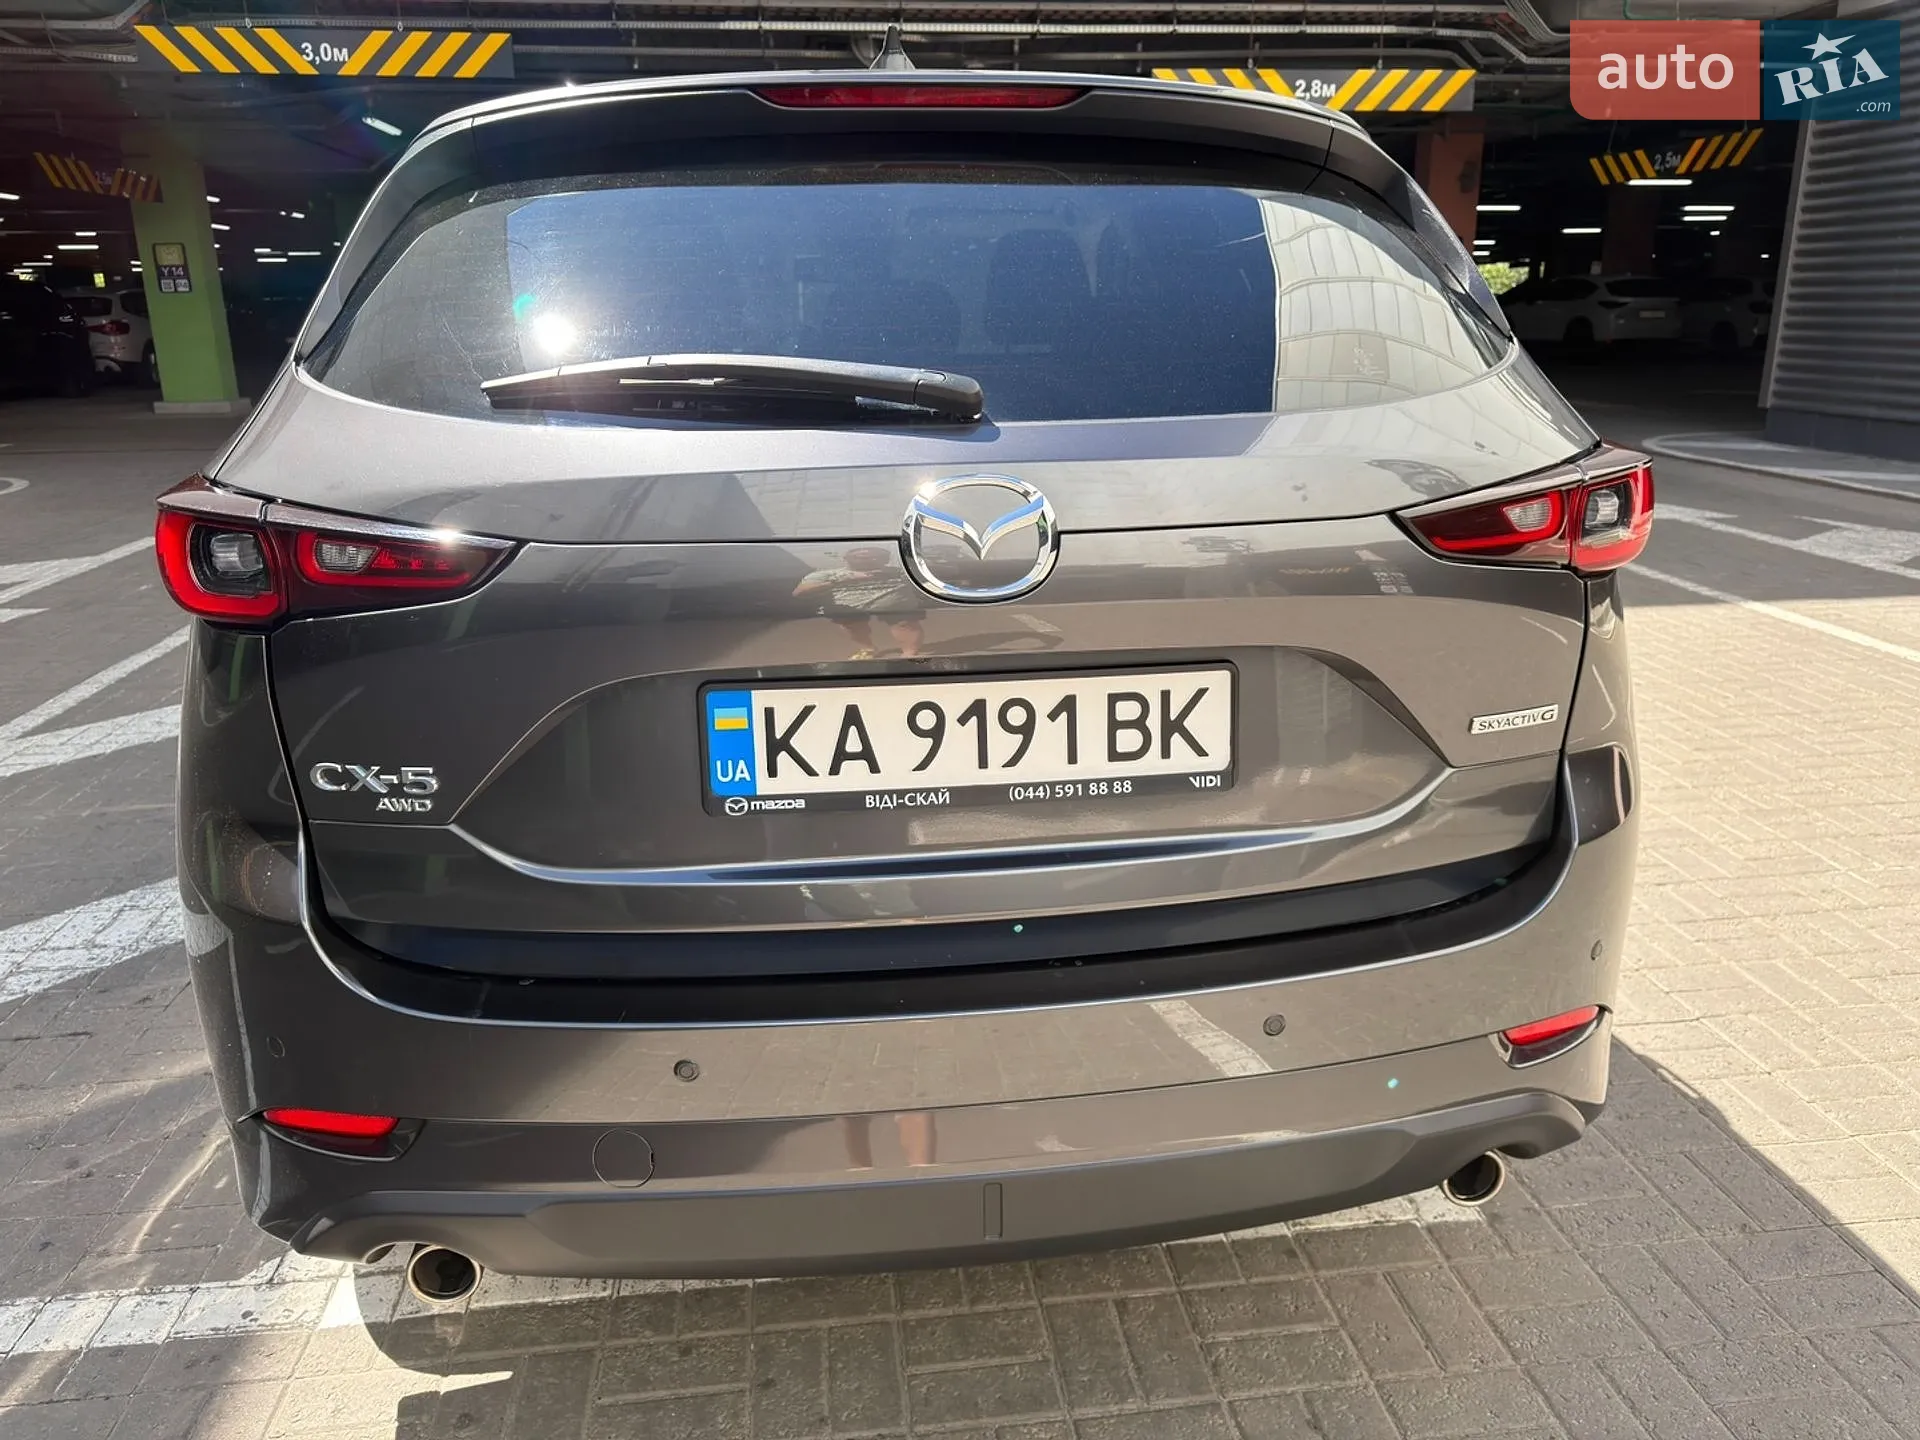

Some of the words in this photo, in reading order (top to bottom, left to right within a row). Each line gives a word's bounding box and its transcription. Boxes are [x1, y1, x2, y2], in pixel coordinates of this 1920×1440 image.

[300, 42, 349, 65] 3,0м
[1294, 79, 1337, 101] 2,8м
[764, 703, 881, 779] KA
[906, 693, 1078, 772] 9191
[1106, 686, 1210, 763] BK
[309, 762, 440, 795] CX-5
[716, 759, 751, 783] UA
[1188, 775, 1222, 788] VIDI
[865, 788, 950, 810] ВІДІ-СКАЙ
[1008, 784, 1051, 801] (044)
[1055, 783, 1083, 798] 591
[1088, 782, 1109, 796] 88
[1113, 780, 1133, 794] 88
[376, 797, 434, 812] AWD
